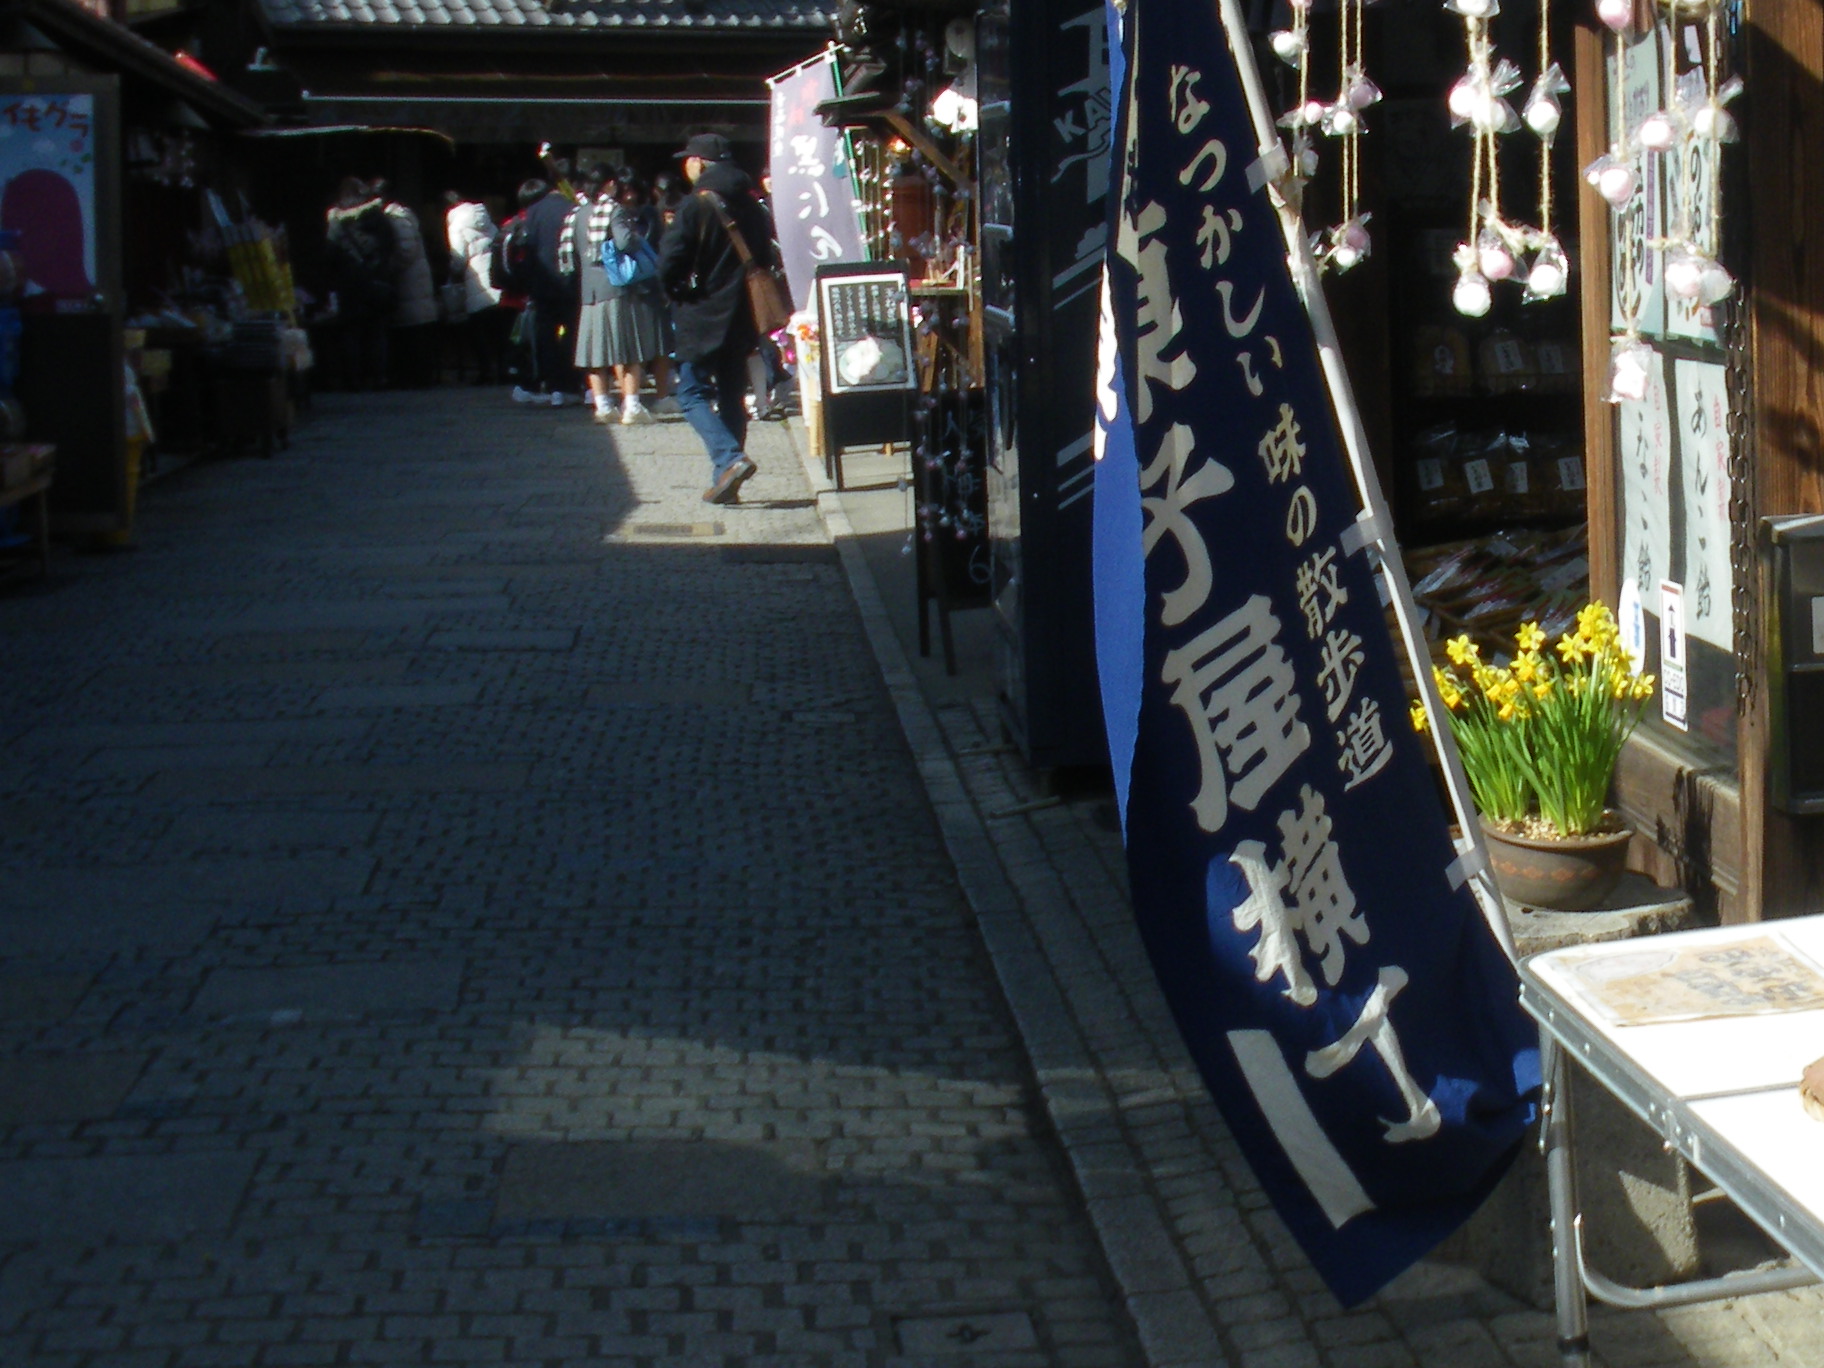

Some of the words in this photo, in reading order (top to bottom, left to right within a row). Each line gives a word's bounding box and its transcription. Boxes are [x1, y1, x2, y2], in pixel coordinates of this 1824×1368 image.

[1168, 62, 1394, 792] なつかしい味の散歩道
